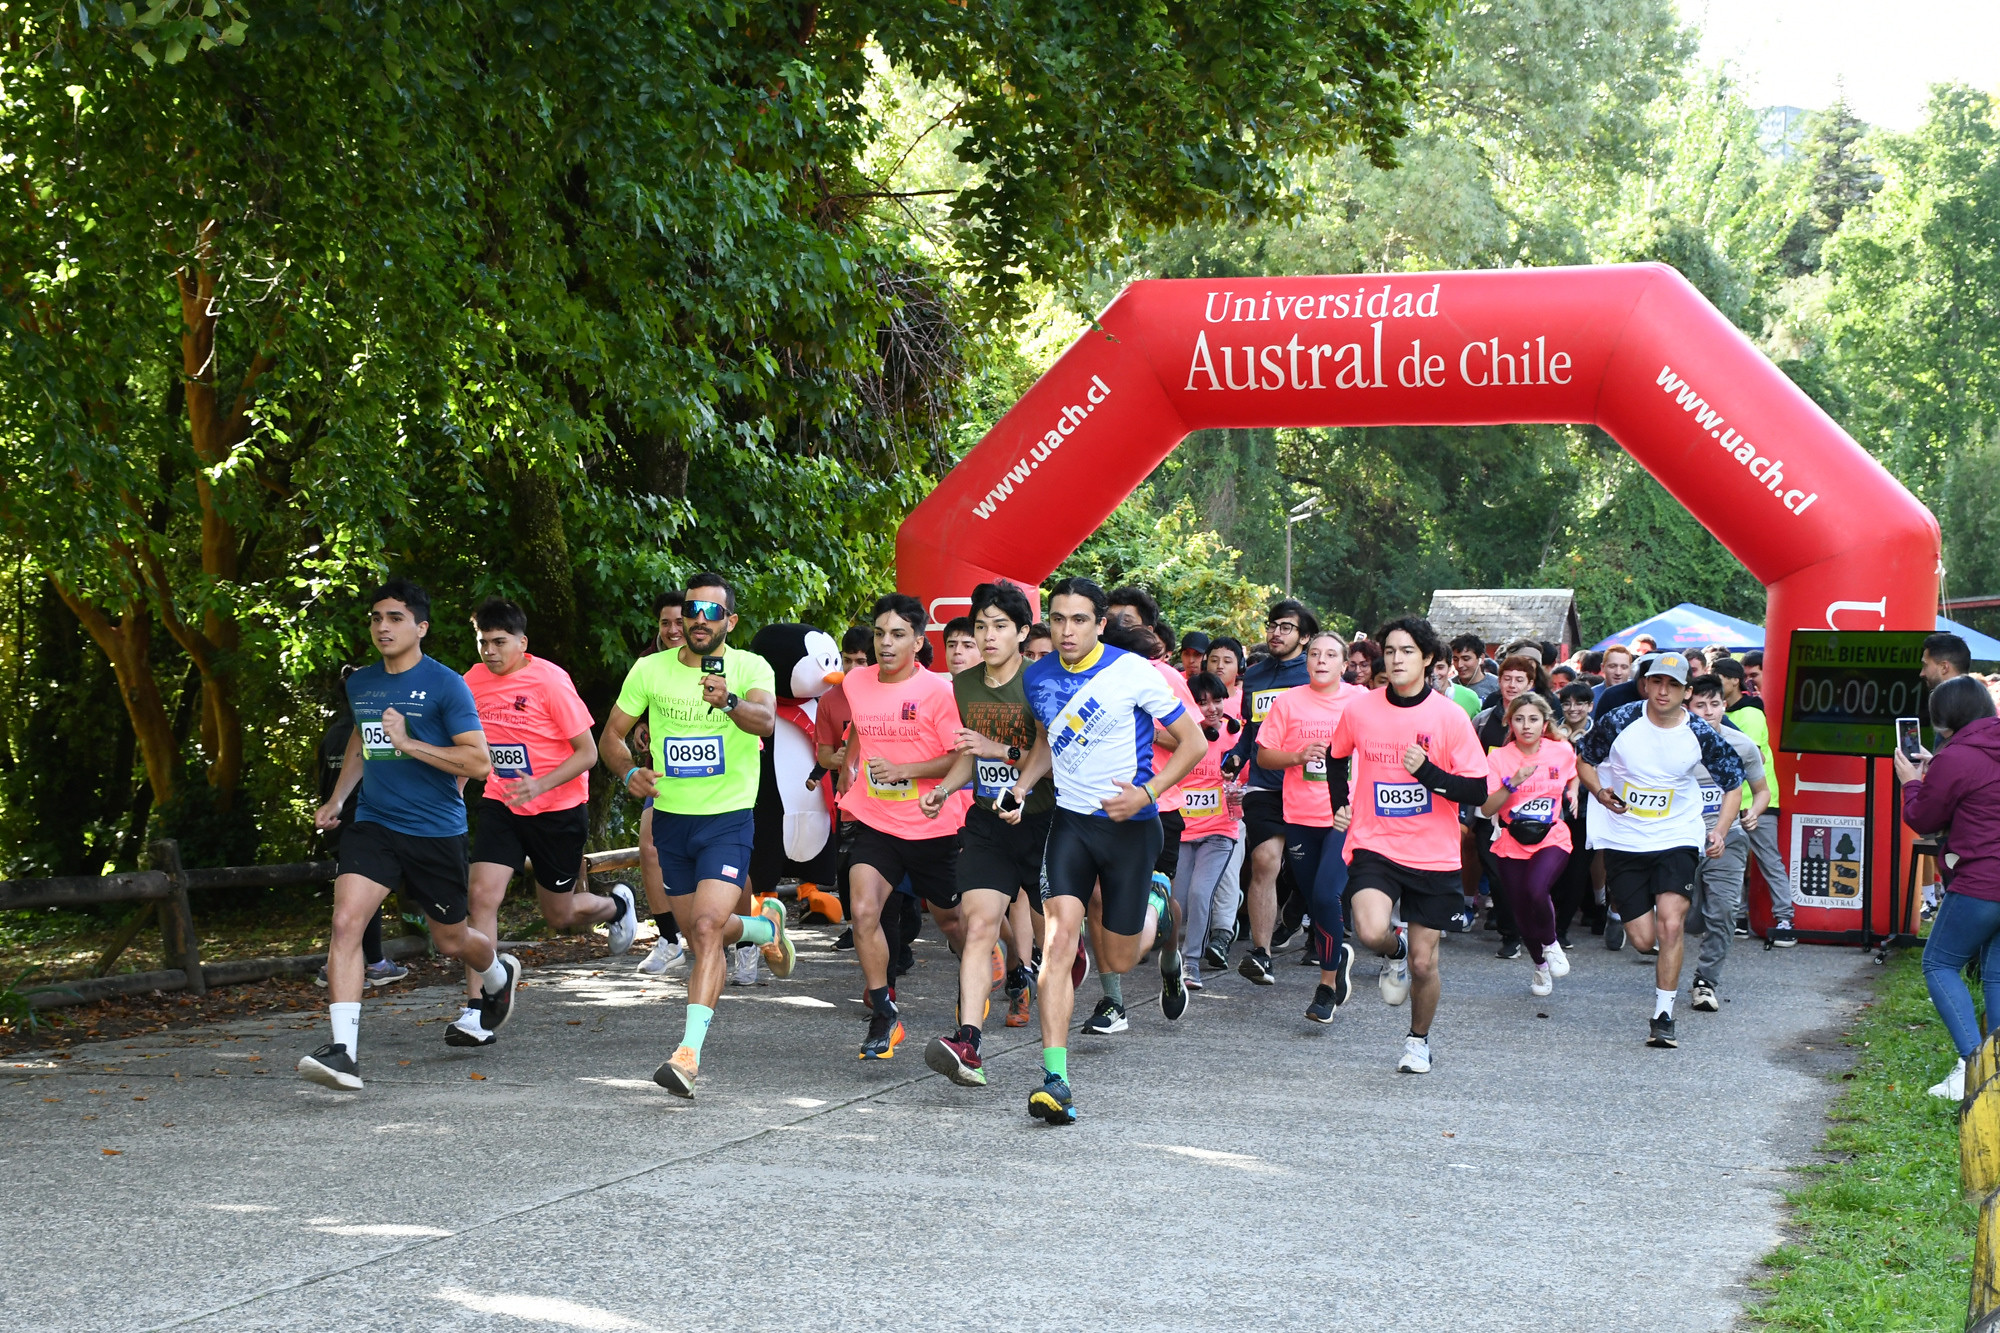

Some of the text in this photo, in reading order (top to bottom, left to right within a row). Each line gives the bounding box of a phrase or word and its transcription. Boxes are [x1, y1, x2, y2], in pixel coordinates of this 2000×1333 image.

[1204, 283, 1441, 323] Universidad
[1184, 319, 1572, 391] Austral de Chile
[972, 375, 1111, 520] www.uach.cl
[1655, 365, 1819, 516] www.uach.cl
[1796, 645, 1835, 662] TRAIL
[1800, 679, 1922, 714] 00:00:01
[1083, 708, 1106, 735] AUSTRIA
[888, 726, 897, 736] de
[899, 726, 921, 737] Chile
[1298, 727, 1334, 739] Austral
[669, 744, 717, 762] 0898
[979, 765, 1021, 782] 0990
[1186, 793, 1216, 807] 0731
[1379, 788, 1425, 804] 0835
[1629, 791, 1667, 807] 0773
[1799, 816, 1832, 825] LIBERTAS
[1820, 898, 1856, 907] AUSTRAL
